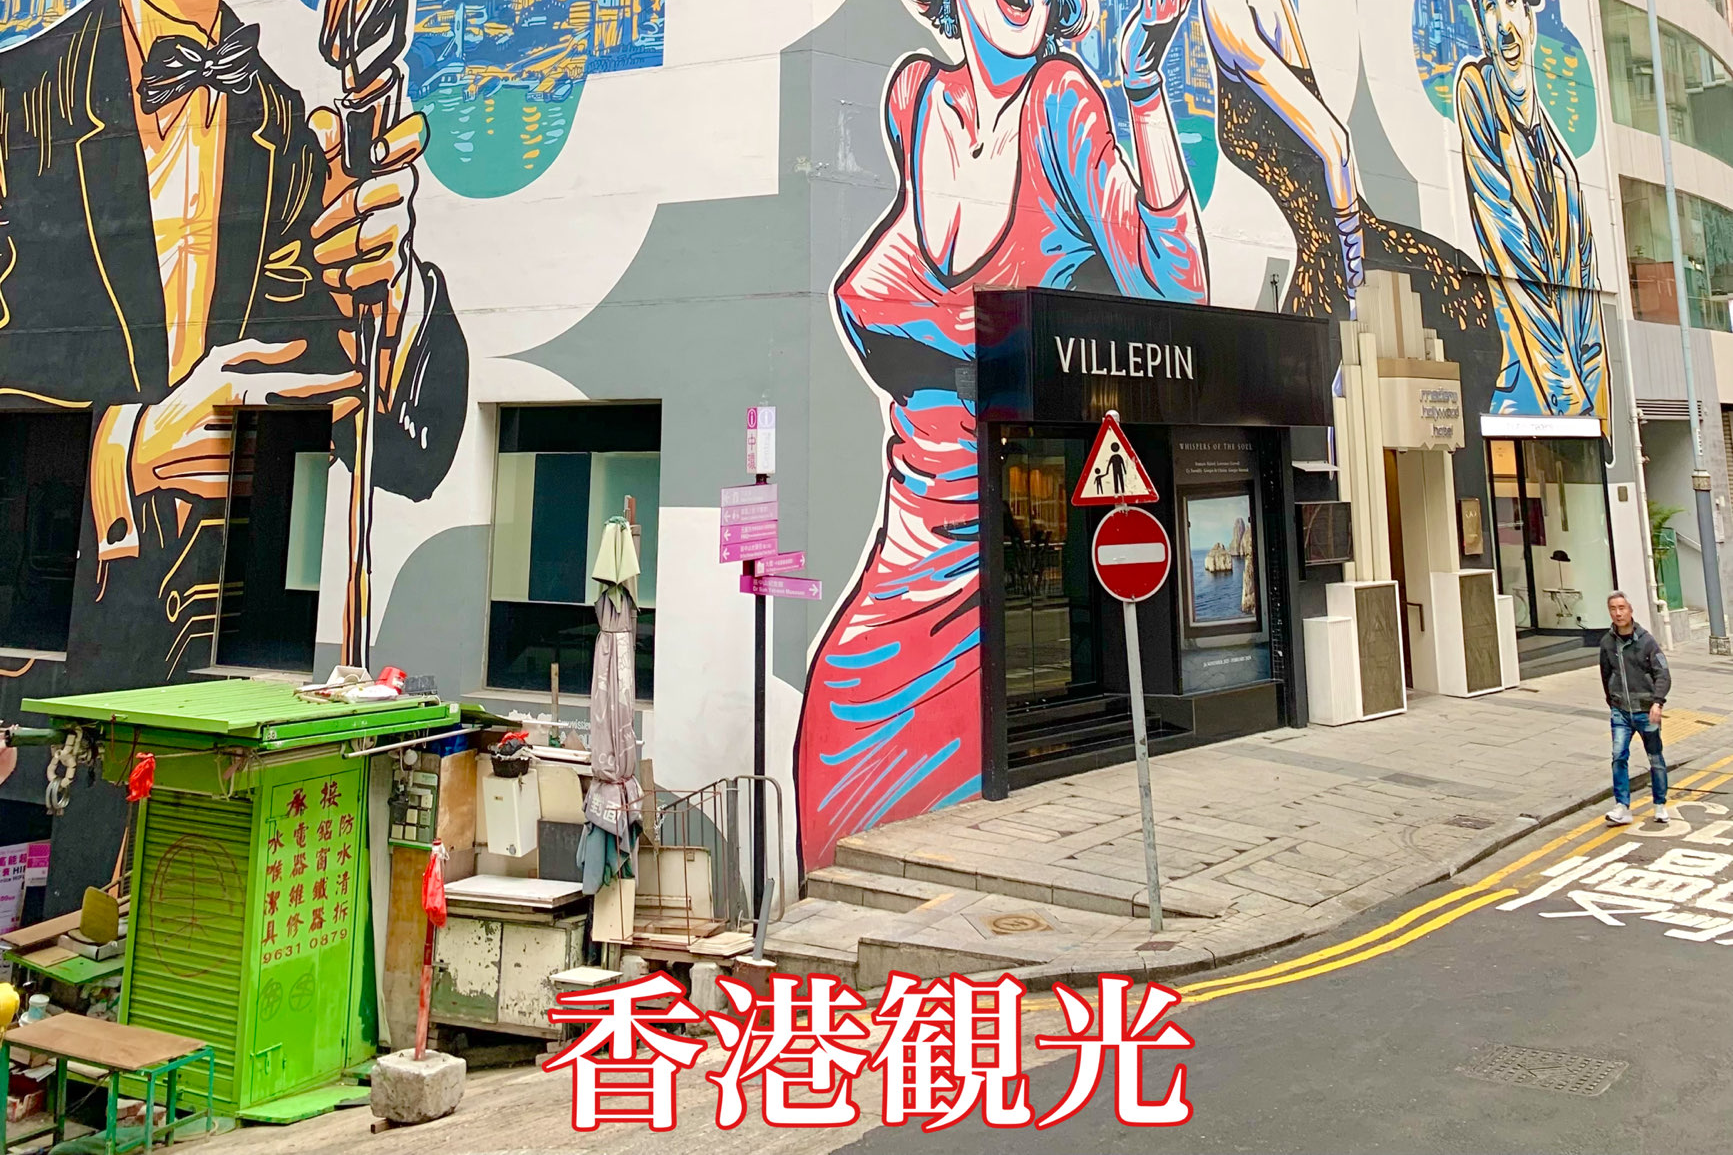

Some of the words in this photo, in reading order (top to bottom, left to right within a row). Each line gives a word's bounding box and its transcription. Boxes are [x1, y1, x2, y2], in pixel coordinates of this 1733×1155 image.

[1054, 335, 1194, 380] VILLEPIN
[1223, 442, 1236, 451] THE
[1432, 423, 1454, 438] hotel
[286, 780, 342, 818] 承接
[261, 829, 285, 946] 水喉潔具
[286, 822, 309, 938] 電器維修
[332, 813, 355, 924] 防水清拆
[262, 942, 301, 964] 9631
[309, 927, 348, 950] 0879
